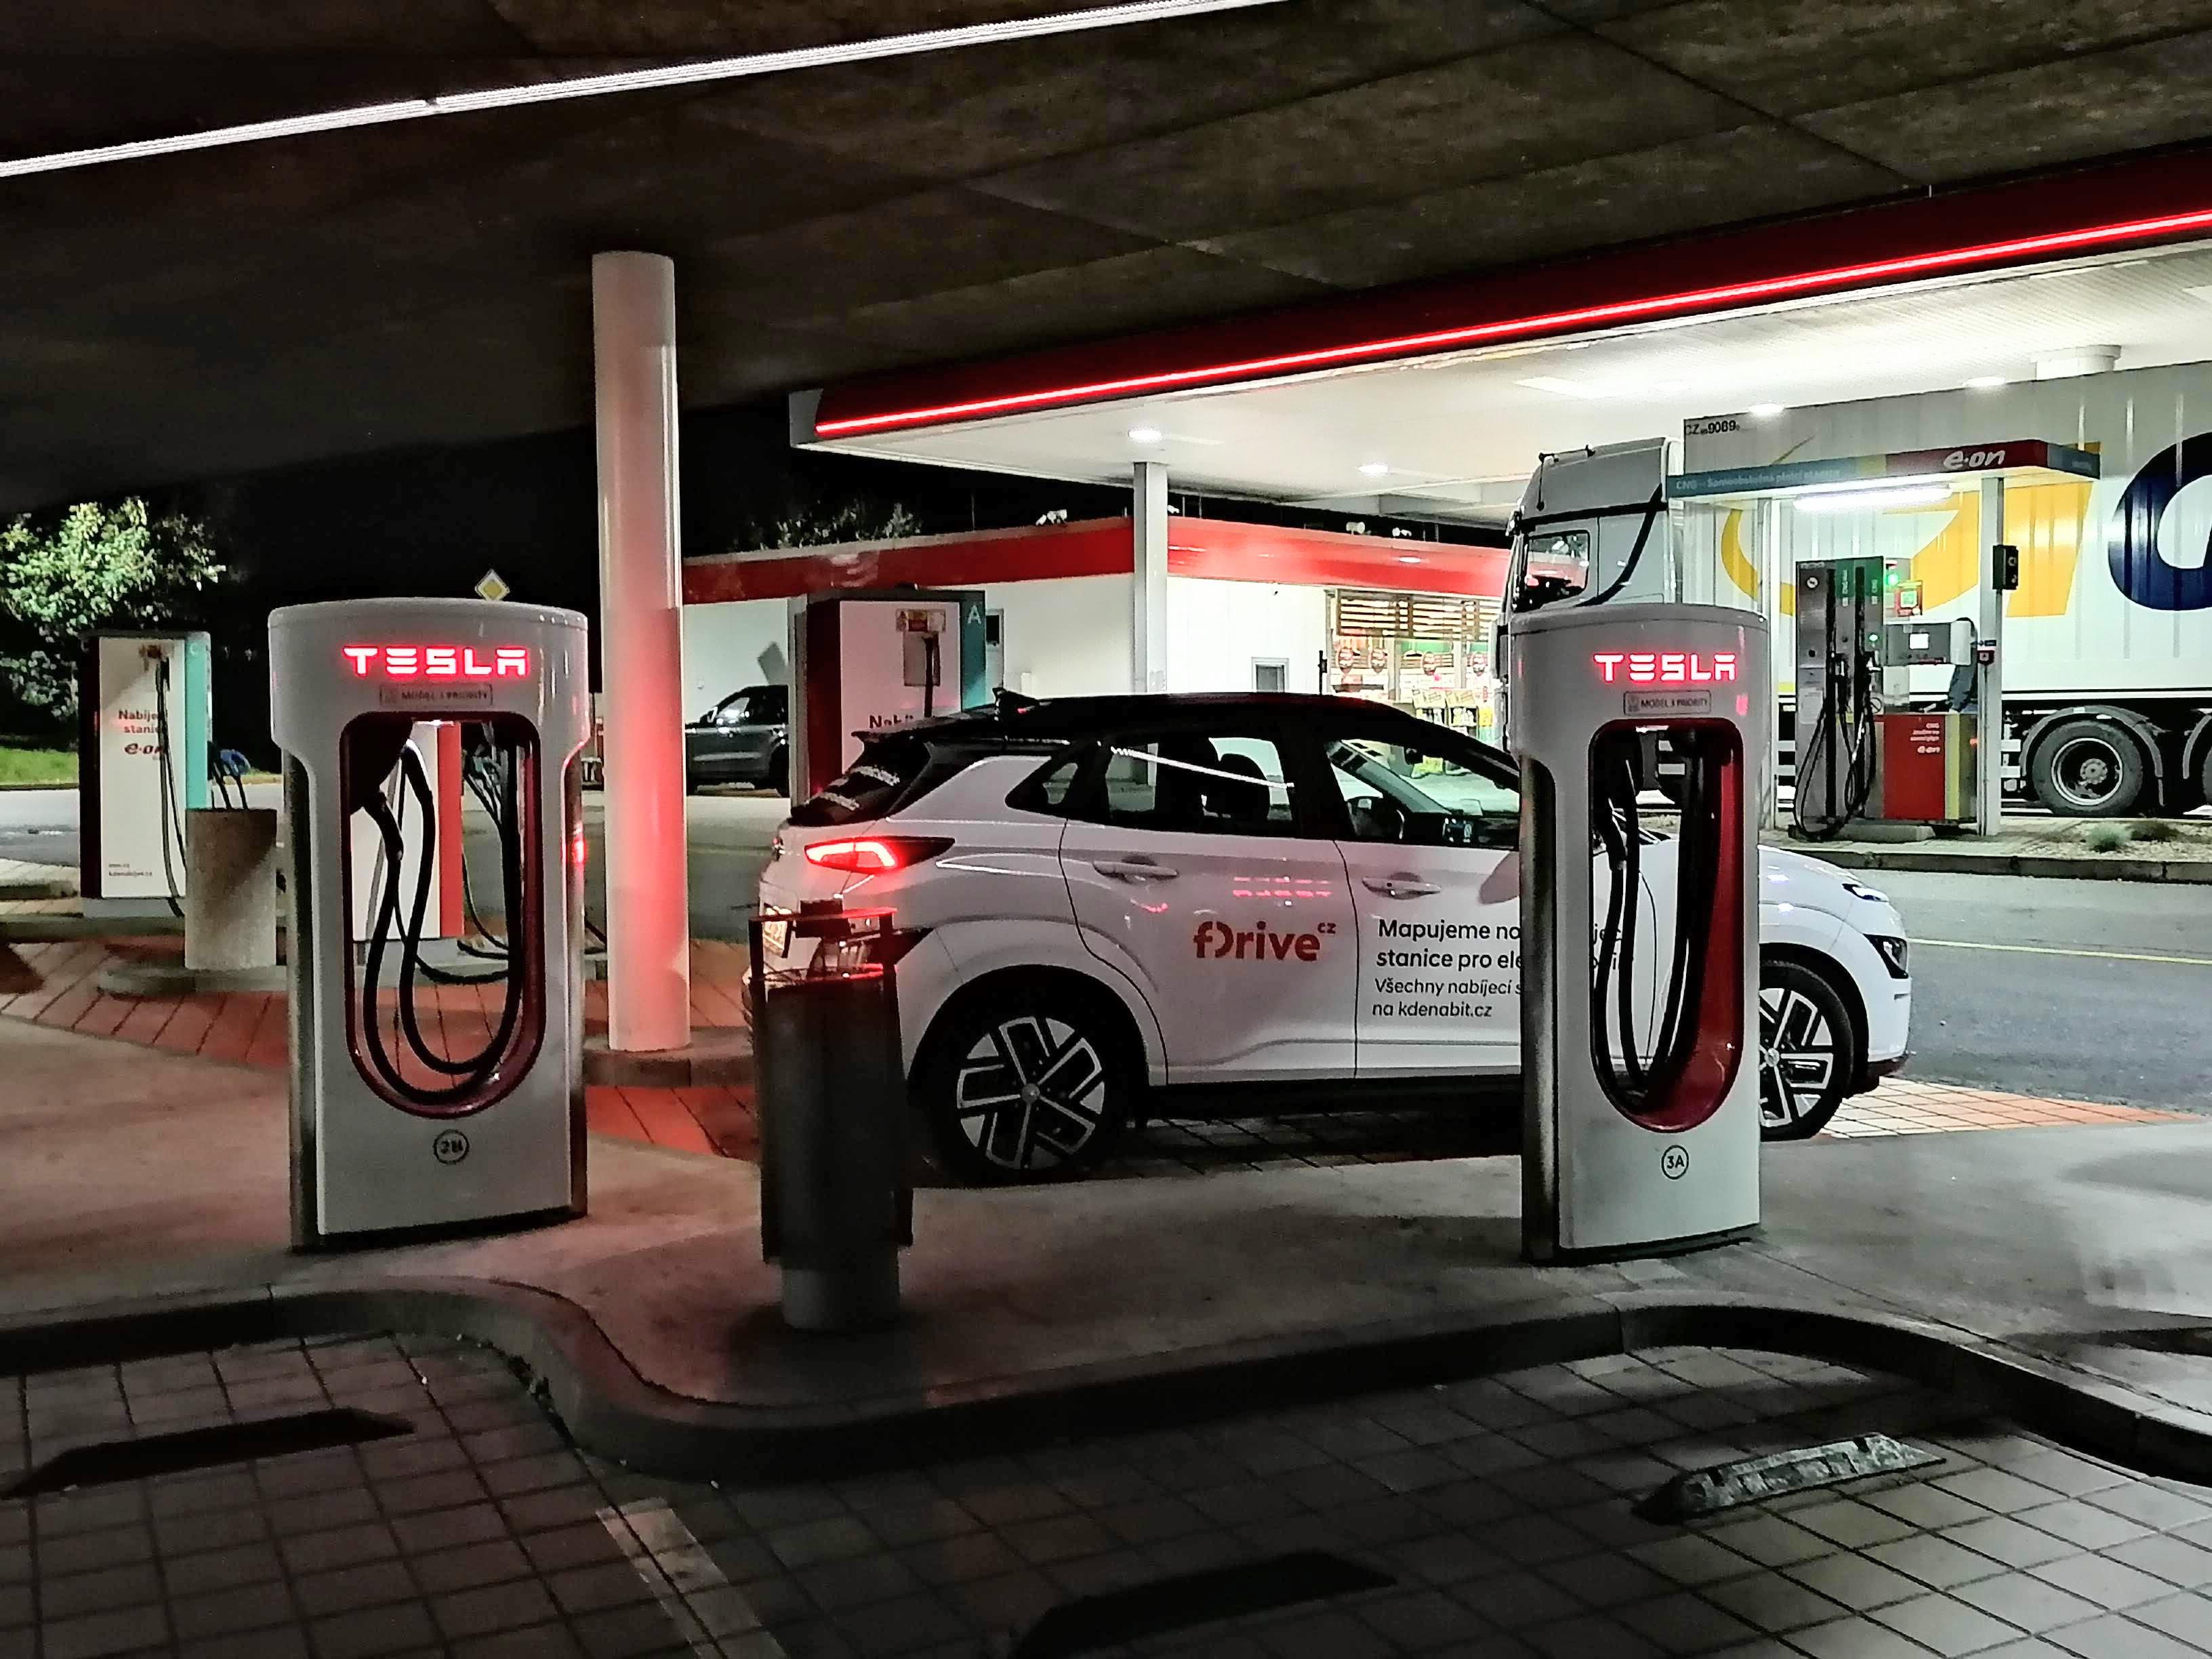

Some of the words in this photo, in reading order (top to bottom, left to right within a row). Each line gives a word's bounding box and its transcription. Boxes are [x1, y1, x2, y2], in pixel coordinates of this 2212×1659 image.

[967, 605, 982, 624] A
[343, 647, 526, 676] TESLA
[1593, 653, 1736, 682] TESLA
[1378, 919, 1490, 942] Mapujeme
[1376, 948, 1453, 967] stanice
[1458, 954, 1492, 972] pro
[1374, 977, 1444, 997] Všechny
[1448, 979, 1513, 998] nabíjecí
[1372, 1004, 1394, 1016] na
[1398, 1001, 1492, 1017] kdenabit.cz
[1666, 1154, 1685, 1170] 3A
